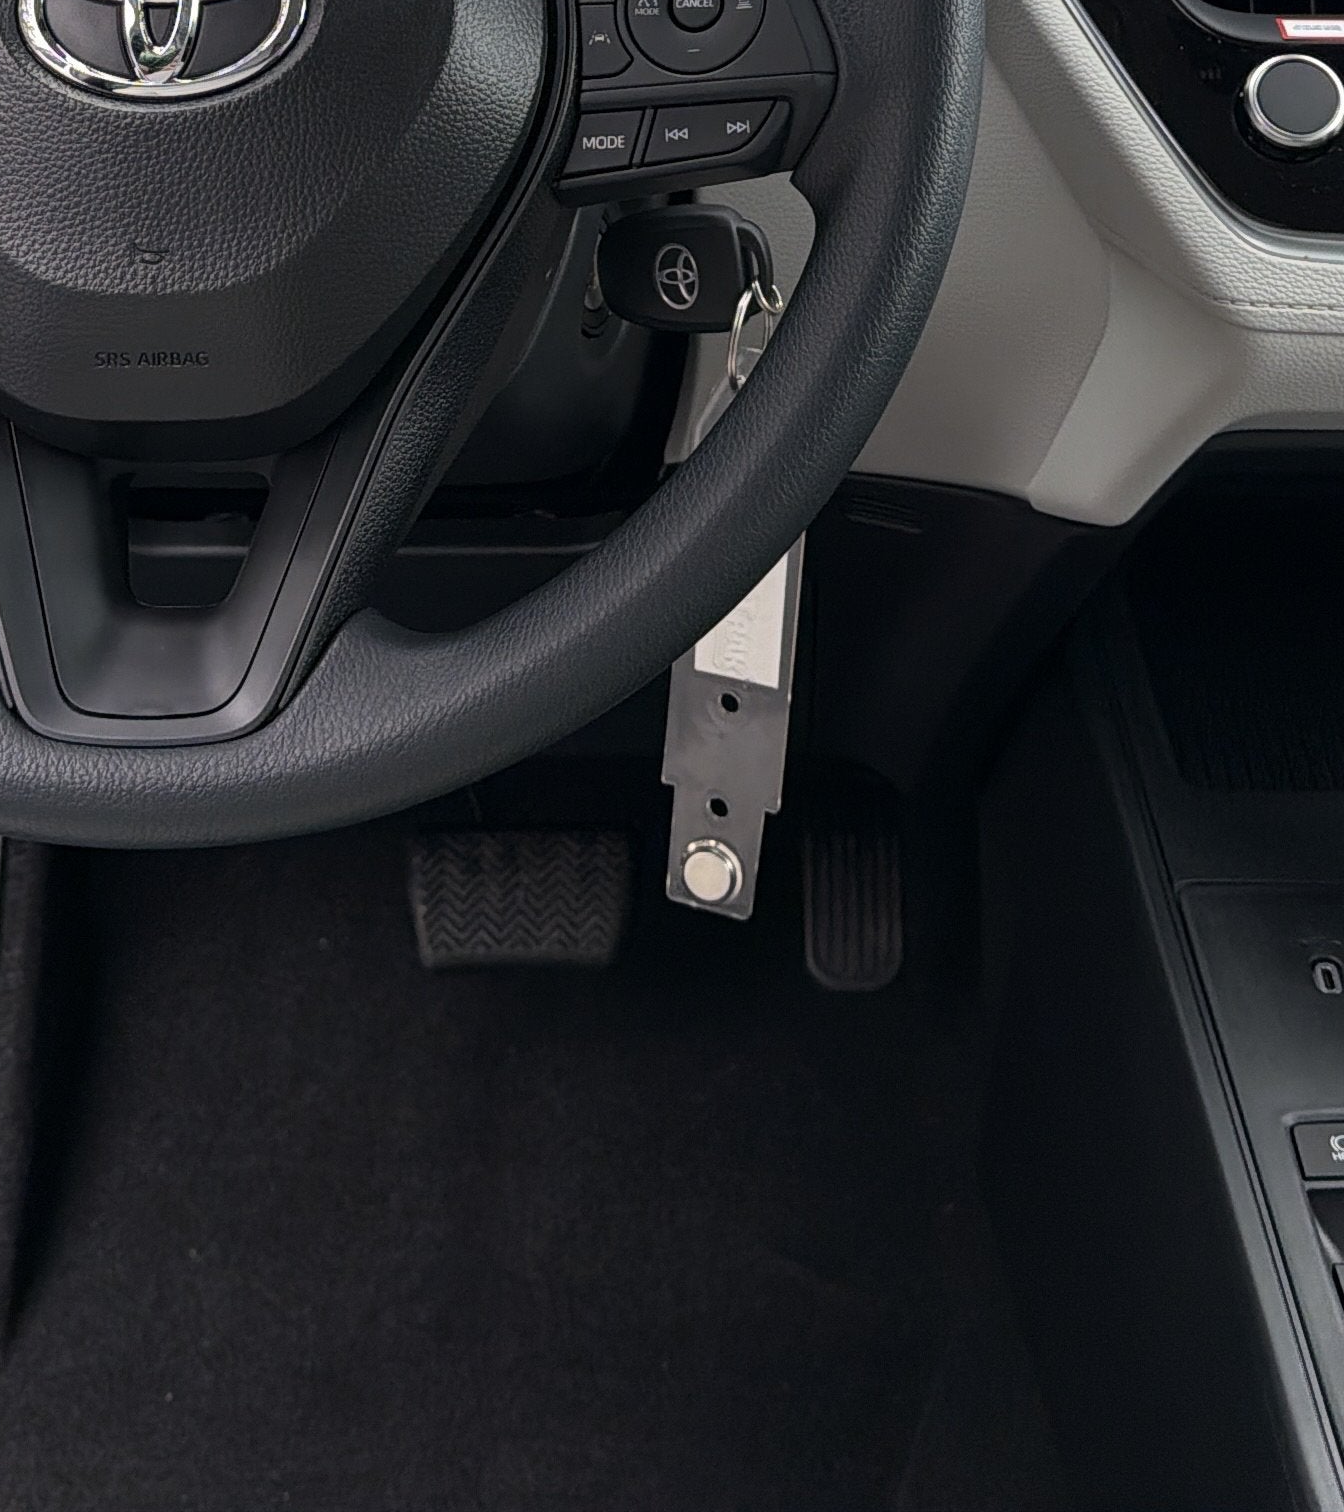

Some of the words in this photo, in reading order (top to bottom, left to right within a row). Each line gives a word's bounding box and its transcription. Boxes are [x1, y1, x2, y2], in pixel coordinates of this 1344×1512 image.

[635, 7, 660, 16] MODE
[582, 135, 625, 149] MODE
[94, 351, 130, 367] SRS
[137, 351, 209, 367] AIRBAG
